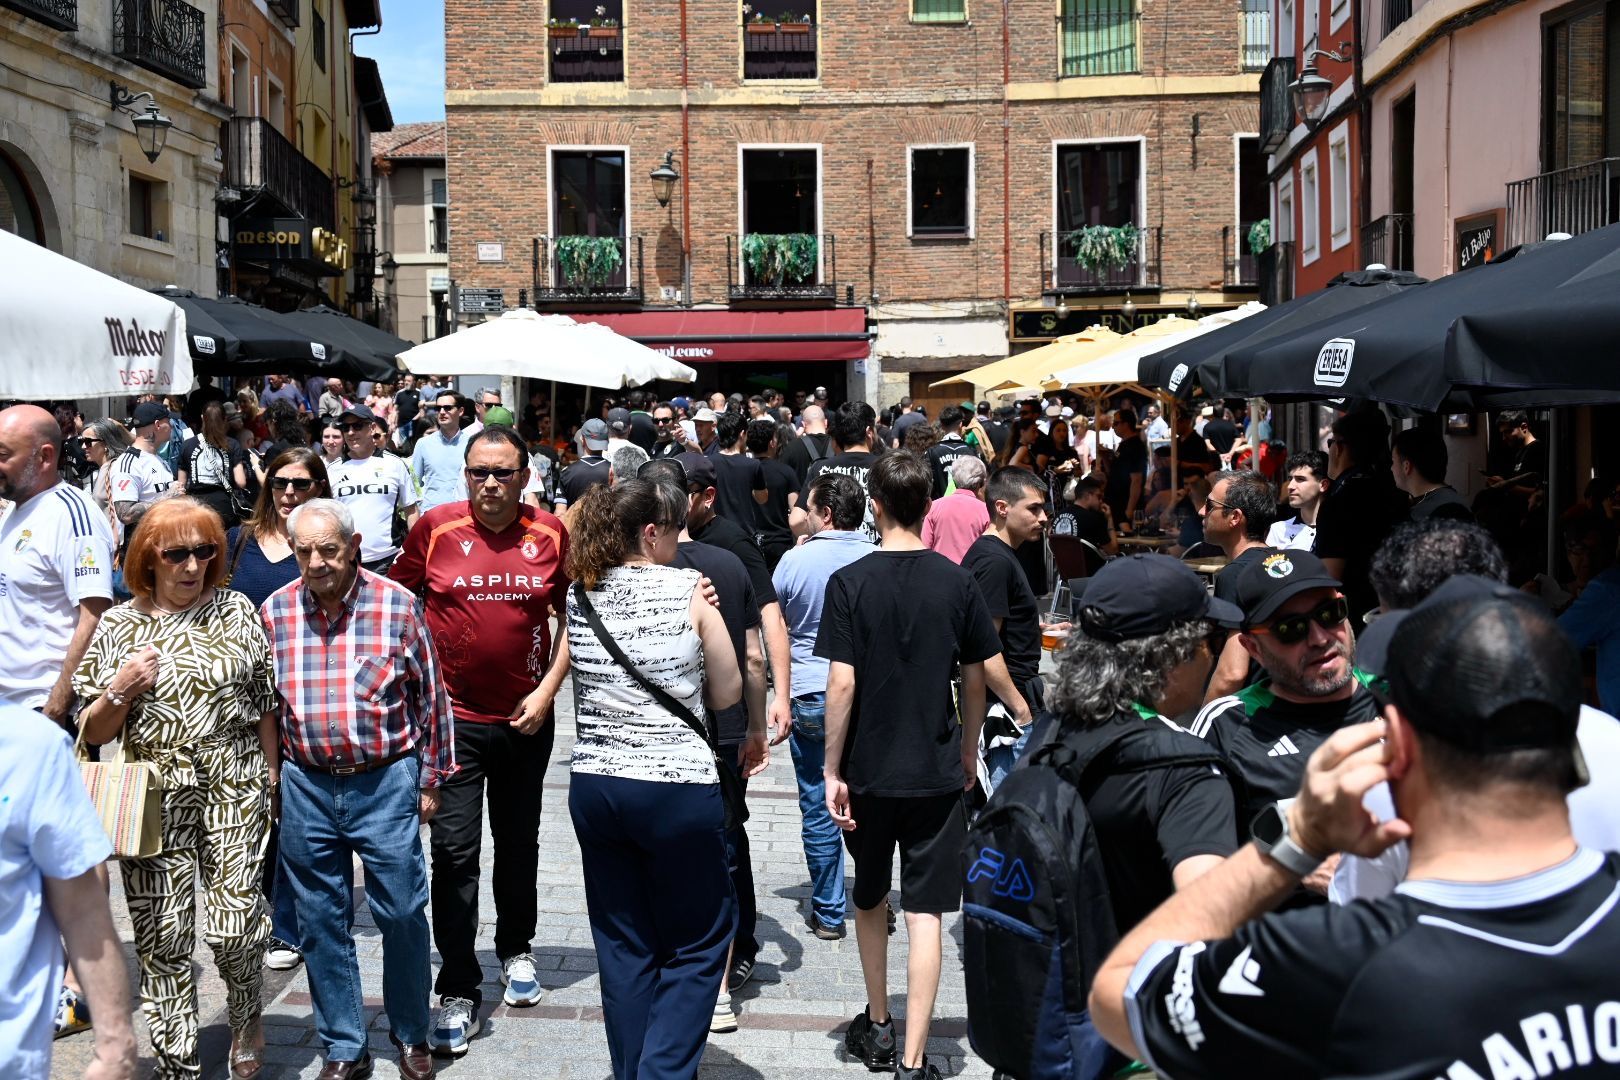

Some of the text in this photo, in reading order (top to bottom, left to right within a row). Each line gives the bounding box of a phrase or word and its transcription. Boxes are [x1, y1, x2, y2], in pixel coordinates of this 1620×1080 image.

[1461, 228, 1491, 267] El Botijo
[119, 369, 155, 386] DSDE
[338, 483, 389, 497] DIGI
[75, 566, 100, 577] GESTTA
[452, 572, 544, 590] ASPIRE
[466, 593, 532, 601] ACADEMY
[1433, 1001, 1620, 1080] ARIO
